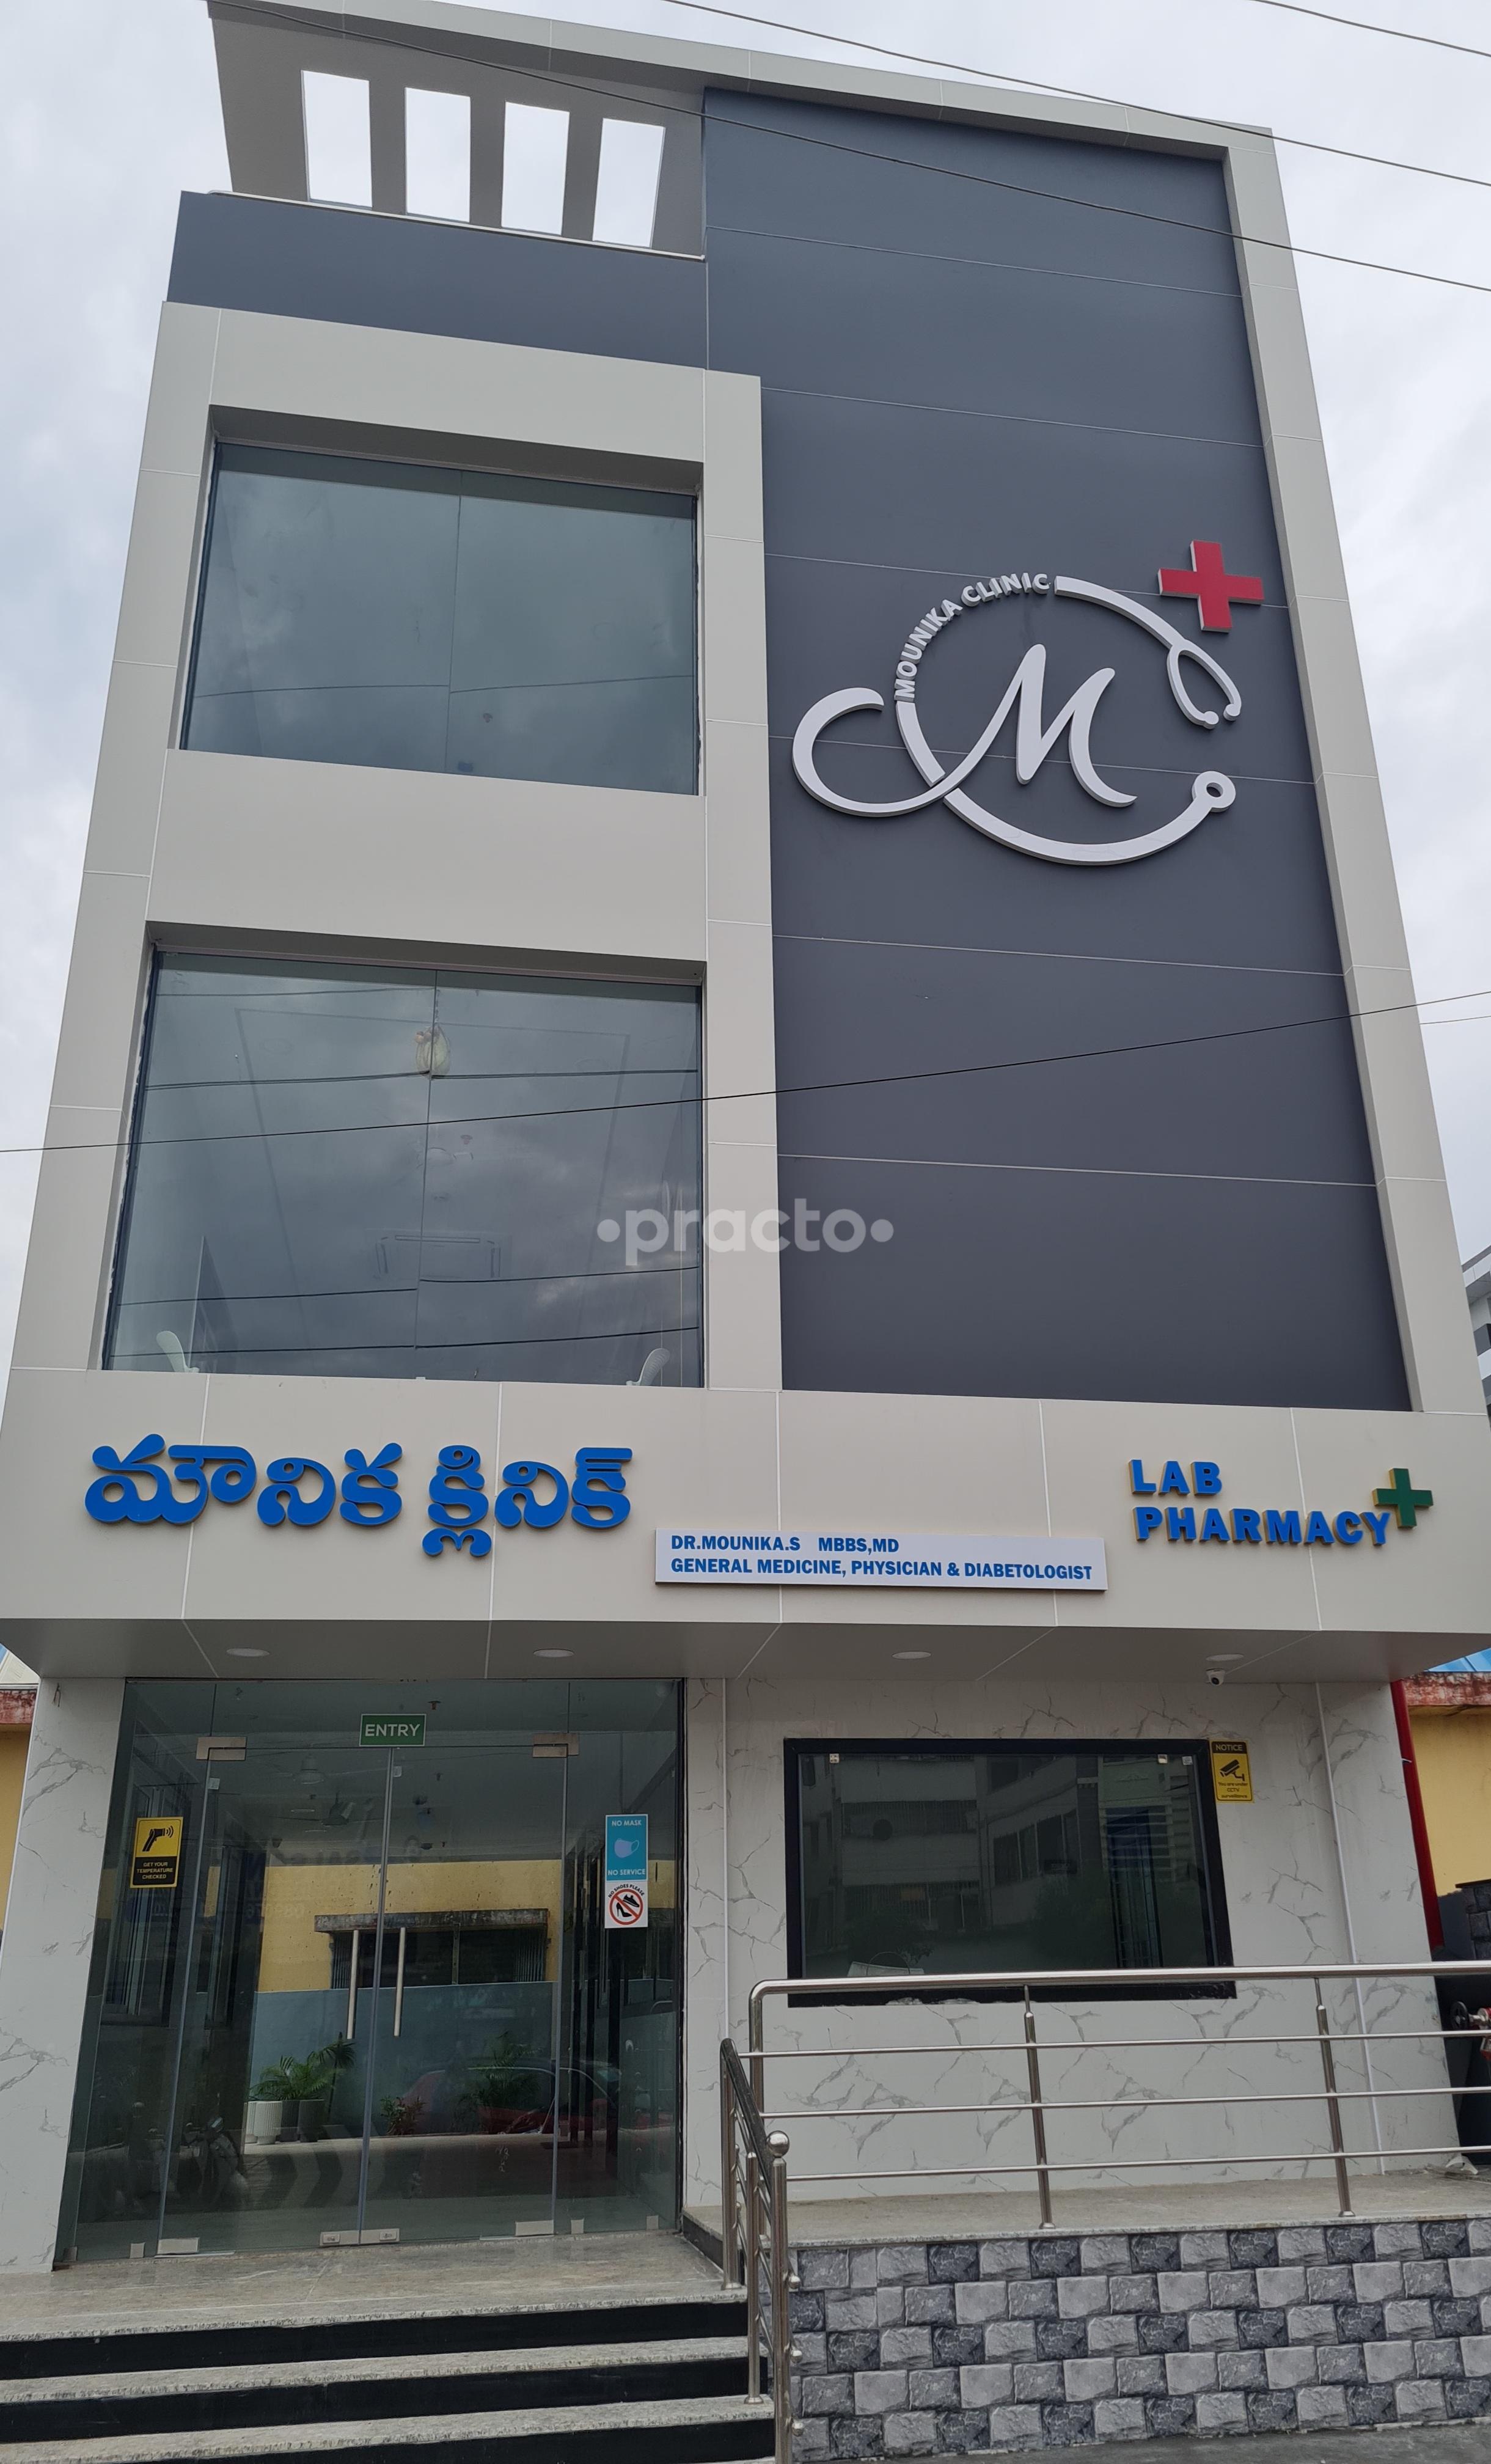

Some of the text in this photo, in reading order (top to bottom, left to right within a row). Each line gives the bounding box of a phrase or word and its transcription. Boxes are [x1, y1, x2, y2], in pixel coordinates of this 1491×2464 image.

[894, 572, 1050, 702] MOUNIKA CLINIC
[1129, 1459, 1223, 1496] LAB
[85, 1434, 633, 1558] మౌనిక క్లినిక్
[1133, 1506, 1391, 1546] PHARMACY
[671, 1535, 899, 1554] DR.MOUNIKA.S MBBS,MD
[671, 1558, 1093, 1580] GENERAL MEDICINE, PHYSICIAN & DIABETOLOGIST
[365, 1723, 421, 1737] ENTRY
[629, 1884, 645, 1896] PLEASE
